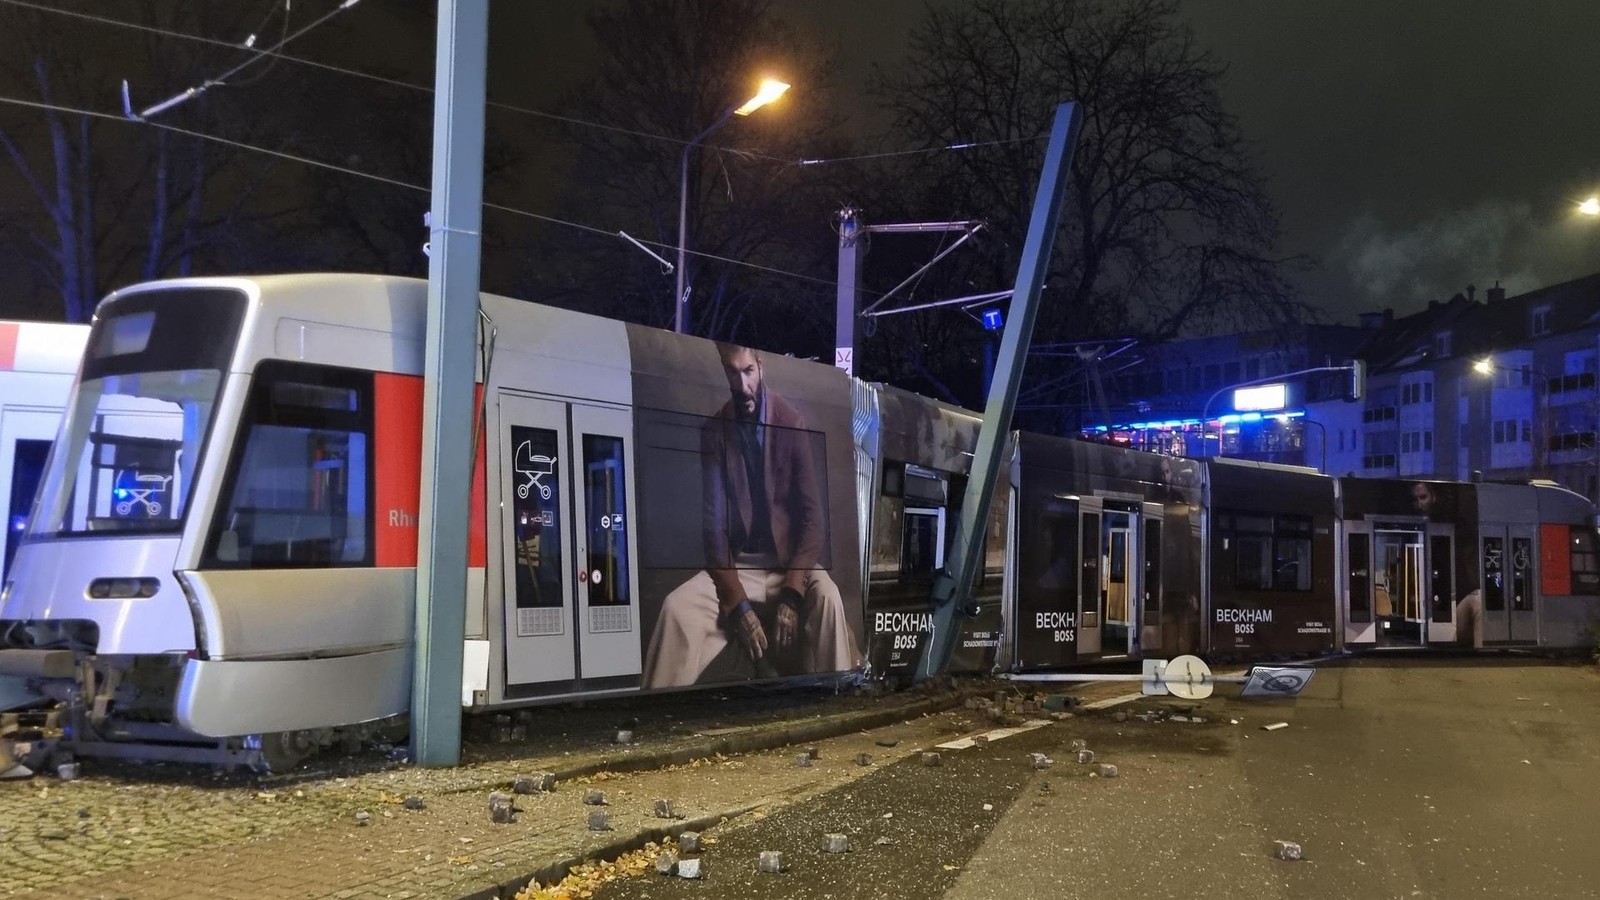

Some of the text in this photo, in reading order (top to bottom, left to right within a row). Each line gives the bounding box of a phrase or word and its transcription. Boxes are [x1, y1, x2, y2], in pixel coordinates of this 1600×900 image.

[986, 312, 998, 325] T
[1036, 612, 1077, 628] BECKH
[1216, 609, 1272, 622] BECKHAM
[1234, 624, 1255, 634] BOSS
[893, 634, 918, 649] BOSS
[1054, 630, 1074, 642] BOSS
